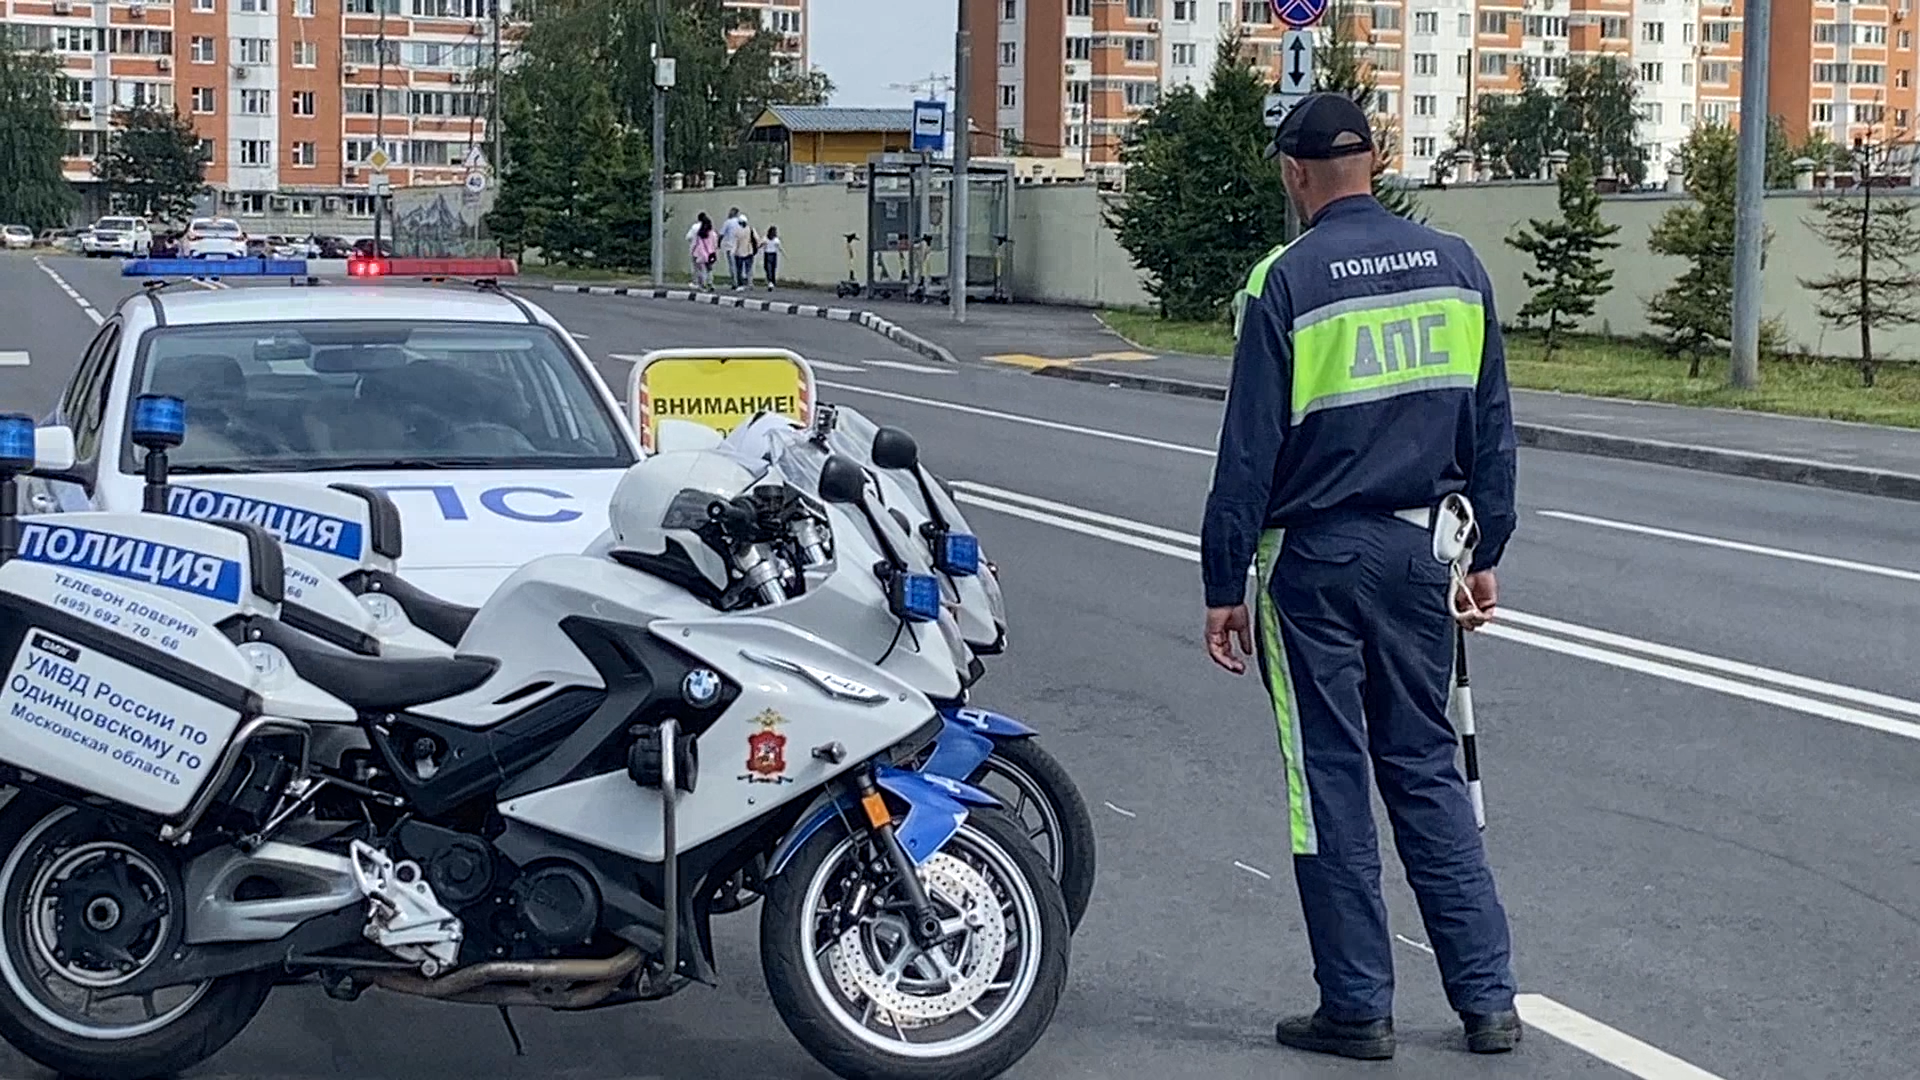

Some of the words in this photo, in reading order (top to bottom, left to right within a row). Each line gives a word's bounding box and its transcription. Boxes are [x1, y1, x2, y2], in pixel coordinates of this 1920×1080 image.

[1329, 250, 1438, 279] ПОЛИЦИЯ
[1349, 313, 1449, 379] ДПС
[653, 395, 795, 415] ВНИМАНИЕ!
[167, 487, 345, 551] ПОЛИЦИЯ
[372, 486, 583, 523] ПС
[17, 525, 223, 592] ПОЛИЦИЯ
[284, 566, 319, 587] ЕРИЯ
[54, 573, 125, 608] ТЕЛЕФОН
[125, 602, 199, 639] ДОВЕРИЯ
[54, 593, 91, 615] (495)
[93, 607, 121, 626] 692
[132, 622, 150, 638] 70
[161, 635, 180, 650] 66
[11, 674, 174, 757] Одинцовскому
[175, 749, 202, 770] го
[25, 651, 91, 697] УМВД
[93, 683, 176, 732] России
[179, 724, 208, 746] по
[10, 702, 109, 754] Московская
[112, 747, 181, 786] область
